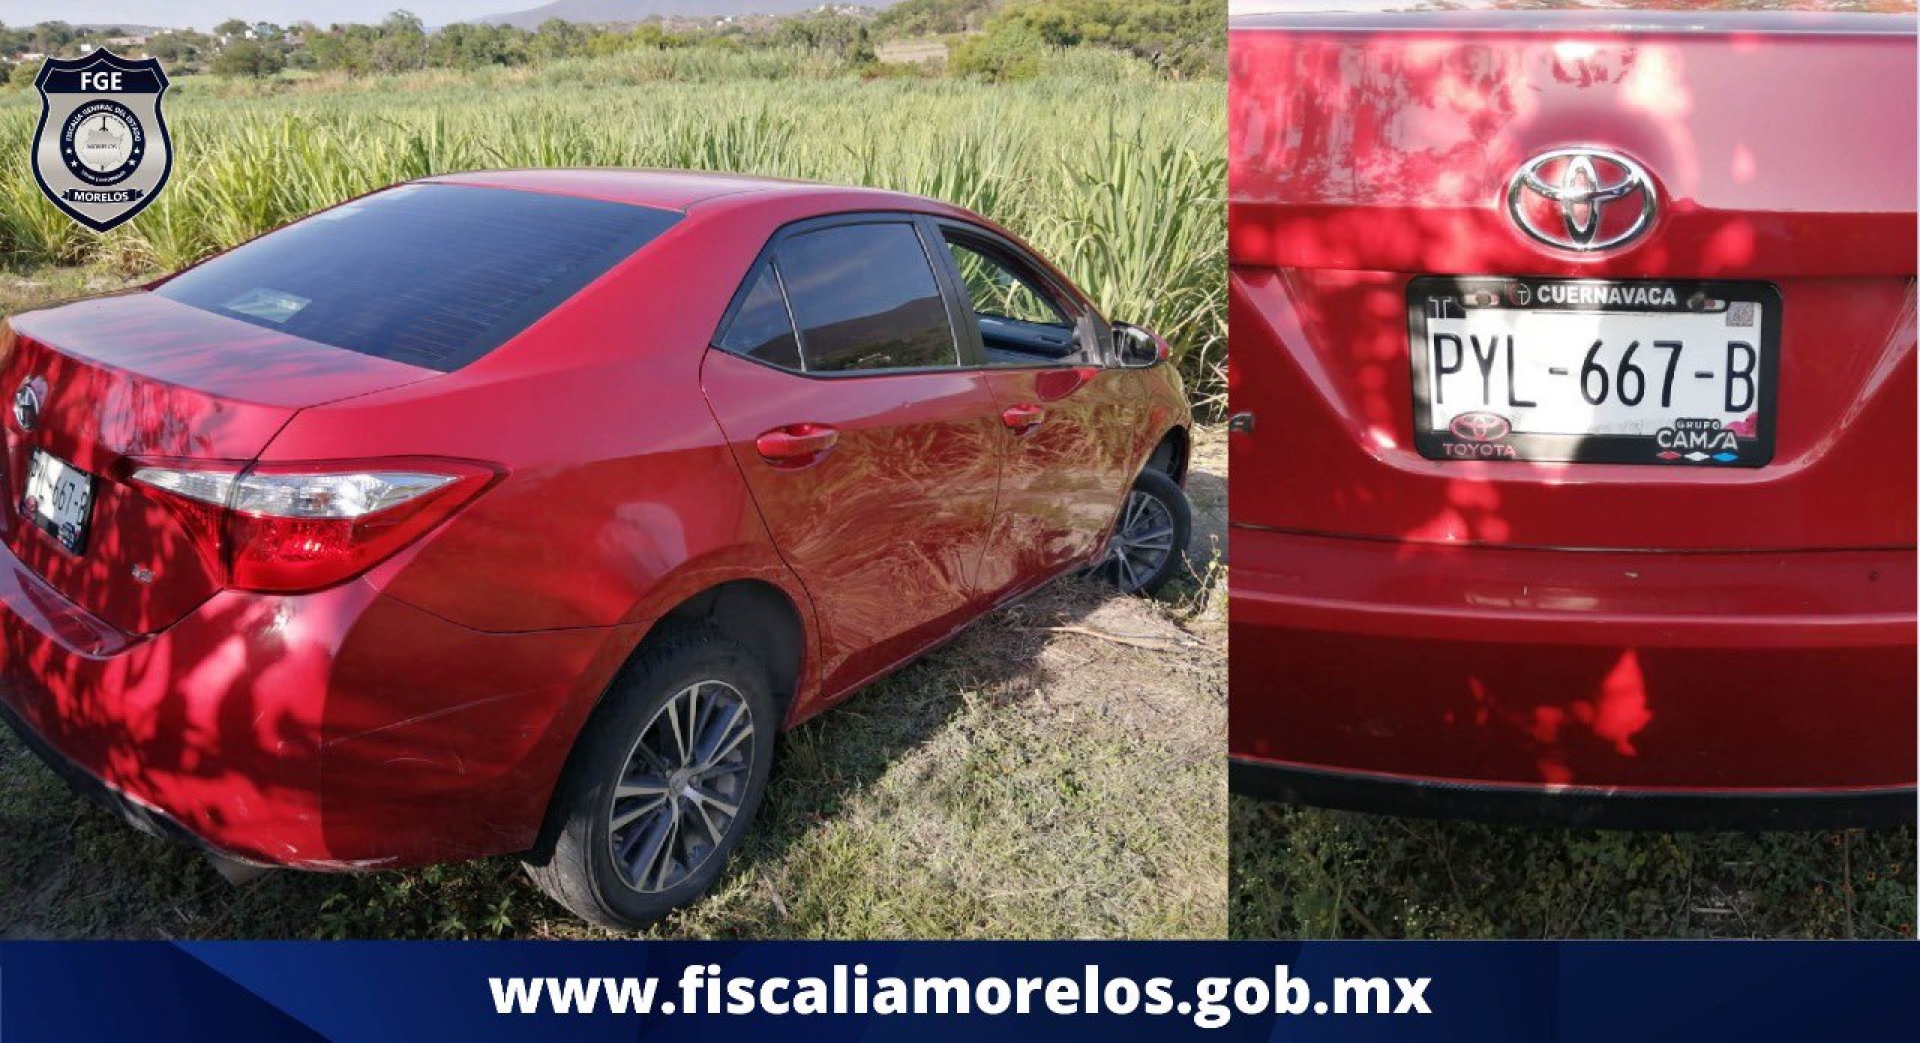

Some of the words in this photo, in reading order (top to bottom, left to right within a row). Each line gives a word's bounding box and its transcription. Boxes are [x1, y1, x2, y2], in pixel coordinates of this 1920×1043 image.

[1537, 284, 1677, 305] CUERNAVACA
[1676, 420, 1721, 431] GRUPO
[1657, 430, 1738, 450] CAMSA
[1443, 443, 1517, 458] TOYOTA
